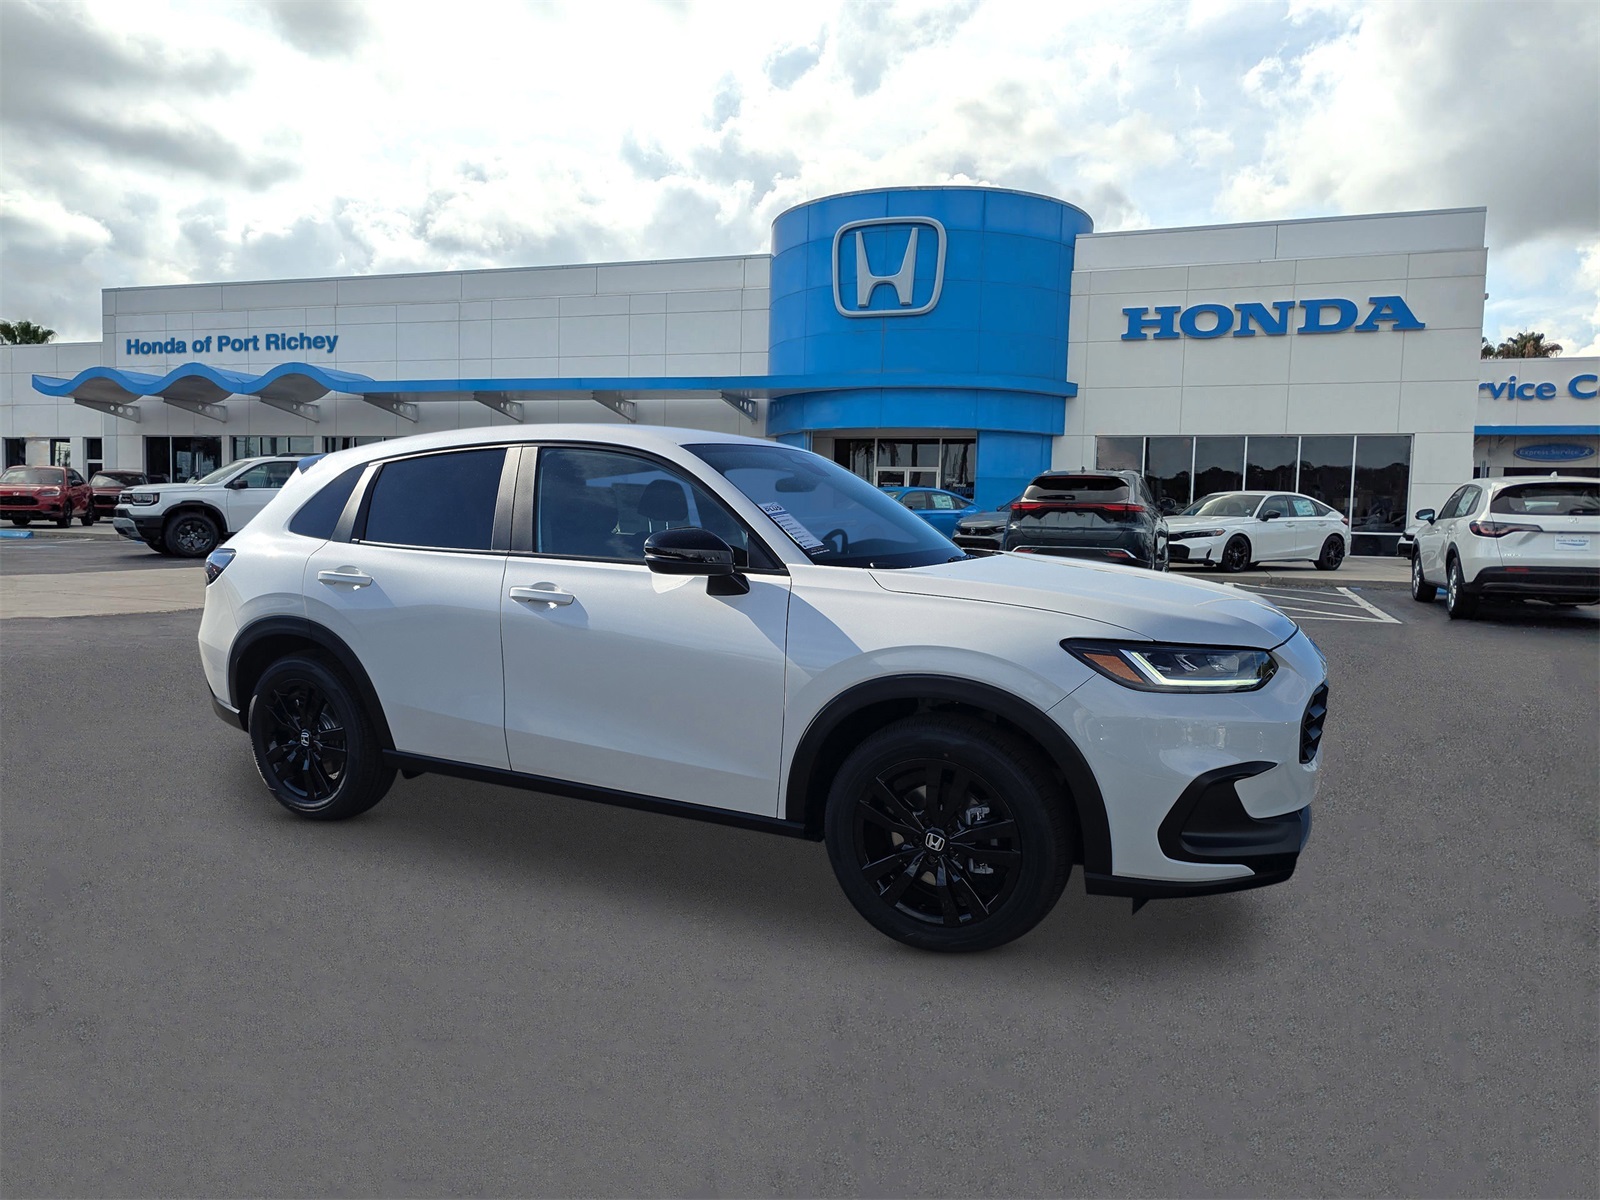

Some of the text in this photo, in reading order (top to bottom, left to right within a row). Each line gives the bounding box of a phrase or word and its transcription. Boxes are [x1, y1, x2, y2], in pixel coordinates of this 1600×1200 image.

[1121, 295, 1426, 341] HONDA
[126, 332, 339, 355] Honda of Port Richey
[1567, 373, 1600, 400] C
